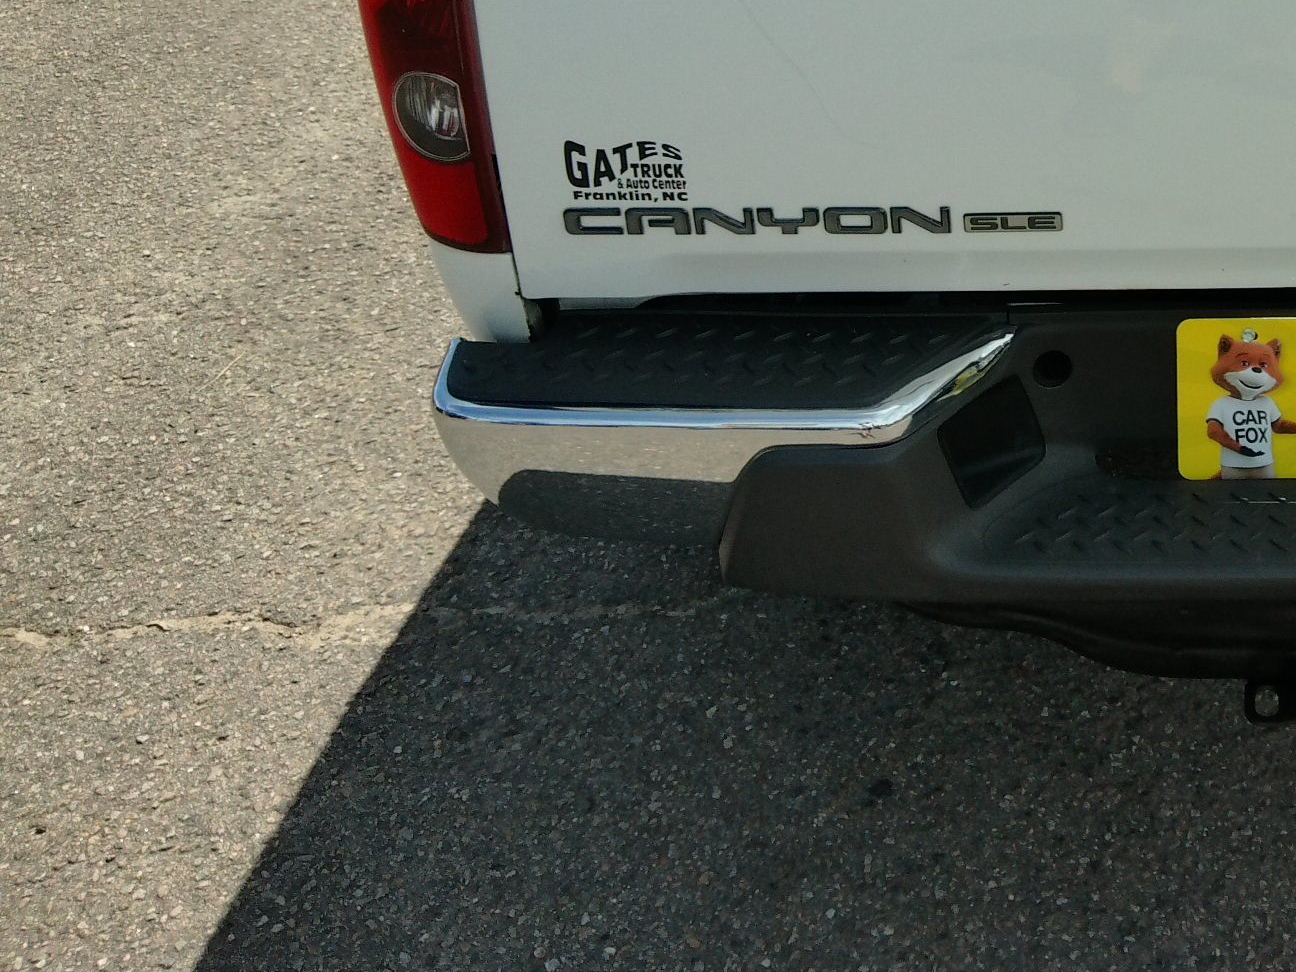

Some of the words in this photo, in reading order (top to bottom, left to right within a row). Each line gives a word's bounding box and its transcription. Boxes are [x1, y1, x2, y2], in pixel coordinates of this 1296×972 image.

[564, 140, 682, 188] GATES
[630, 163, 684, 178] TRUCK
[617, 178, 624, 189] &
[626, 178, 650, 189] Auto
[652, 178, 687, 190] Center
[573, 190, 659, 202] Franklin,
[662, 191, 689, 201] NC
[563, 206, 952, 235] CANYON
[970, 215, 1058, 230] SLE
[1232, 409, 1268, 426] CAR
[1234, 427, 1268, 444] FOX
